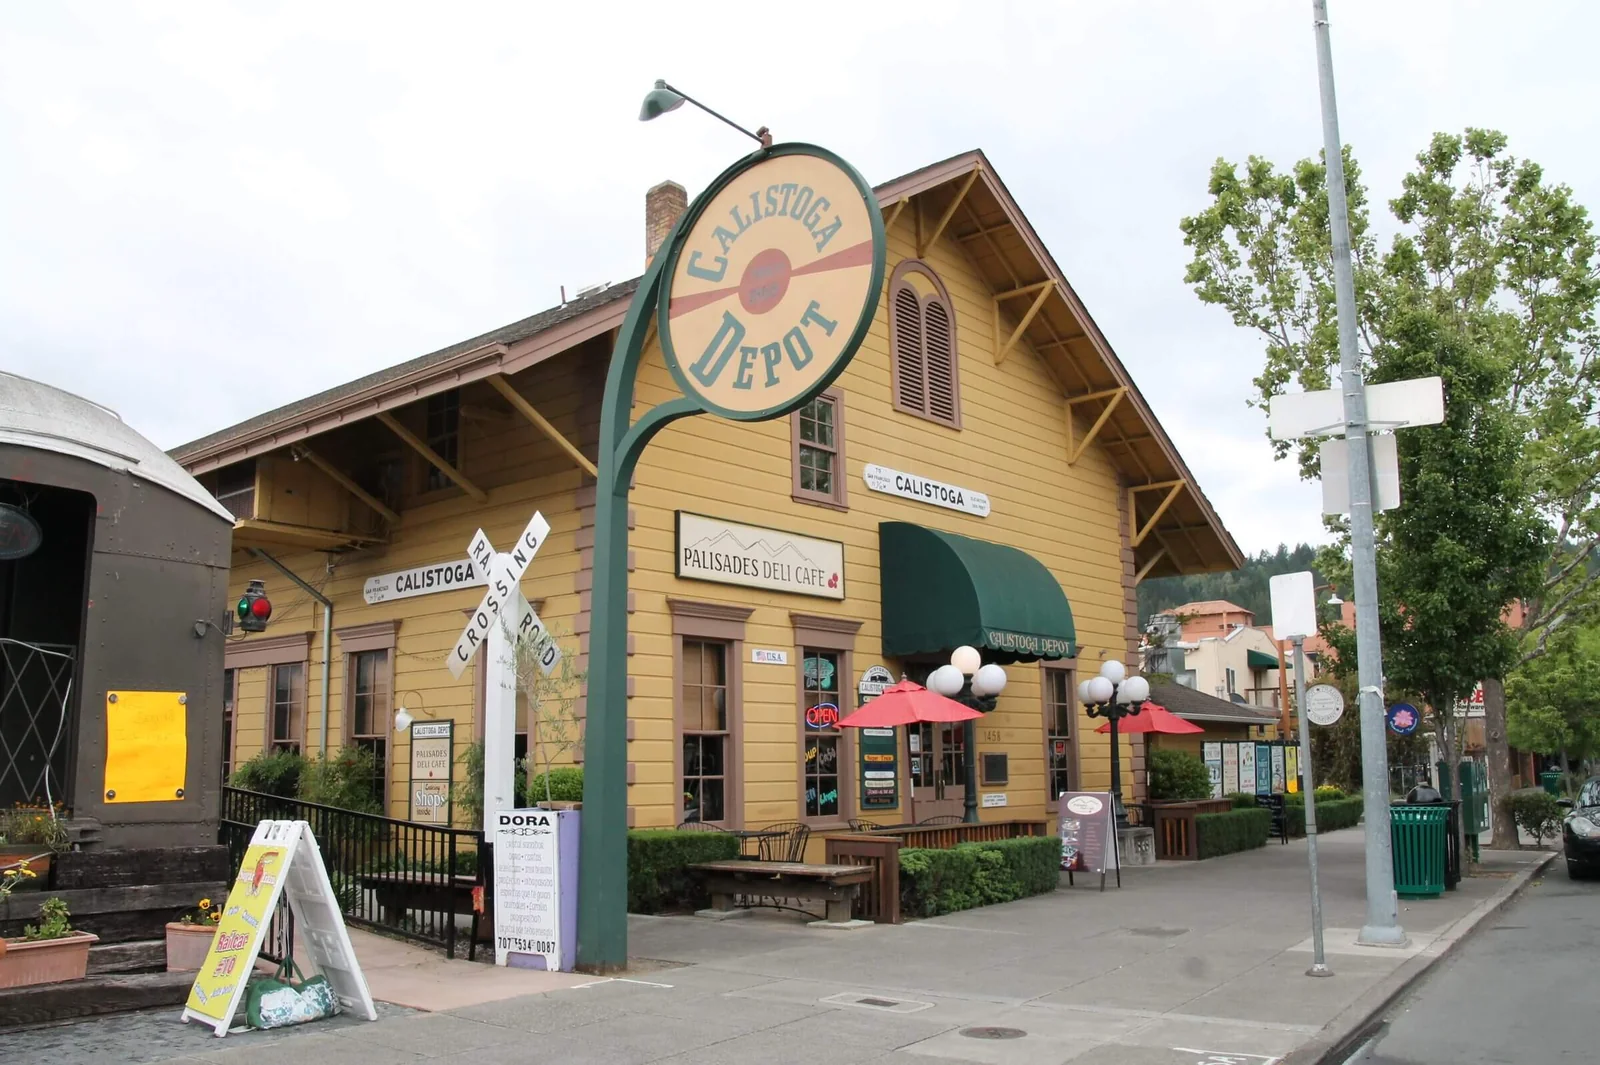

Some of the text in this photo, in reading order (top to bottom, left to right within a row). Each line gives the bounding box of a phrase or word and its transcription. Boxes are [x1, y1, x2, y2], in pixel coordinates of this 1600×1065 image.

[686, 183, 843, 283] CALISTOGA
[688, 299, 839, 390] DEPOT
[895, 475, 965, 506] CALISTOGA
[396, 562, 475, 593] CALISTOGA
[684, 547, 825, 587] PALISADES DELI CAFE
[457, 531, 538, 662] CROSSING
[989, 631, 1070, 654] CALISTOGA DEPOT
[807, 707, 837, 723] OPEN
[416, 749, 448, 758] PALISADES
[416, 784, 446, 818] Shops
[500, 815, 550, 826] DORA
[214, 930, 249, 953] Railcar
[498, 936, 511, 950] 707
[537, 940, 556, 953] 0087
